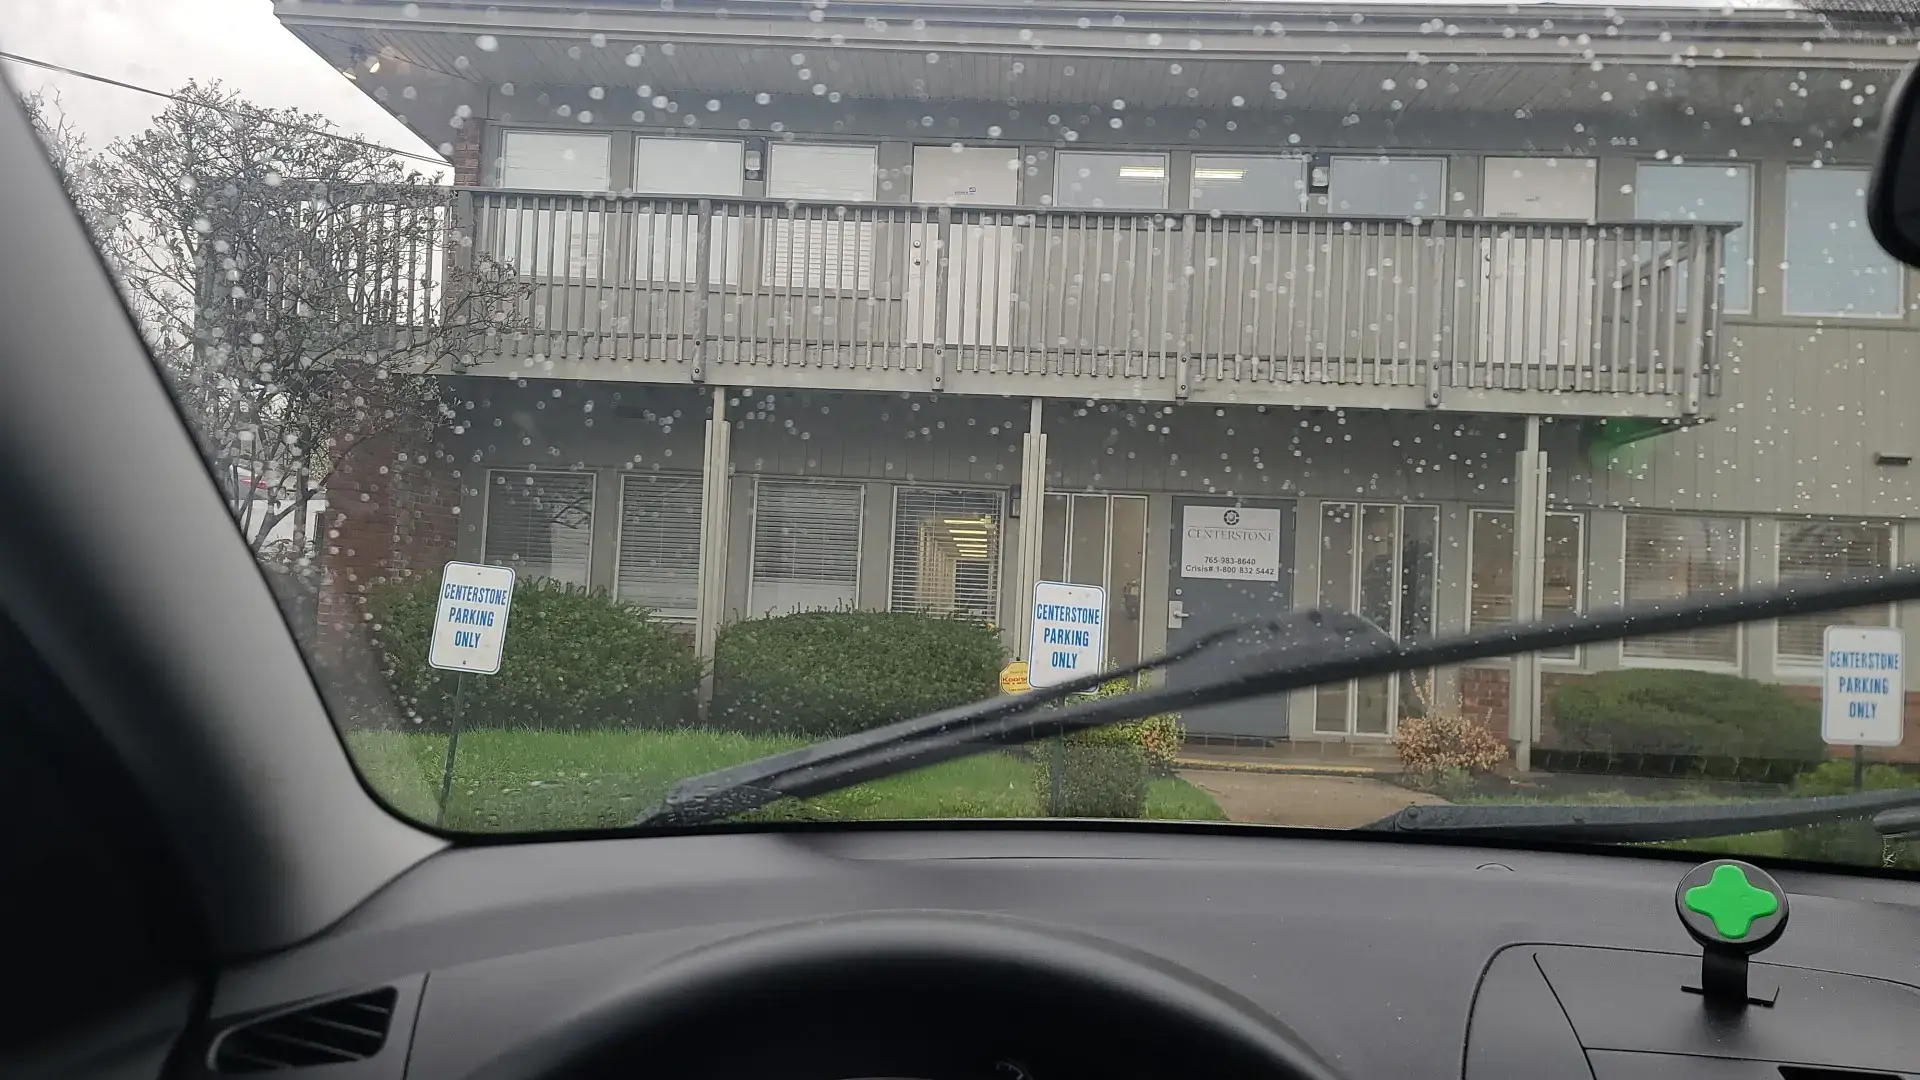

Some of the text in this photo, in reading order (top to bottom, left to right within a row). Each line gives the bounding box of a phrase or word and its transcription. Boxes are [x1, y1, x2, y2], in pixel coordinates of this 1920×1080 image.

[1188, 528, 1276, 541] CENTERSTONE
[1204, 556, 1255, 565] 765-983-8640
[444, 583, 508, 606] CENTERSTONE
[448, 606, 495, 627] PARKING
[1036, 603, 1100, 625] CENTERSTONE
[454, 630, 482, 649] ONLY
[1043, 627, 1090, 647] PARKING
[1051, 651, 1078, 669] ONLY
[1829, 651, 1899, 670] CENTERSTONE
[1838, 676, 1889, 694] PARKING
[1848, 701, 1877, 719] ONLY
